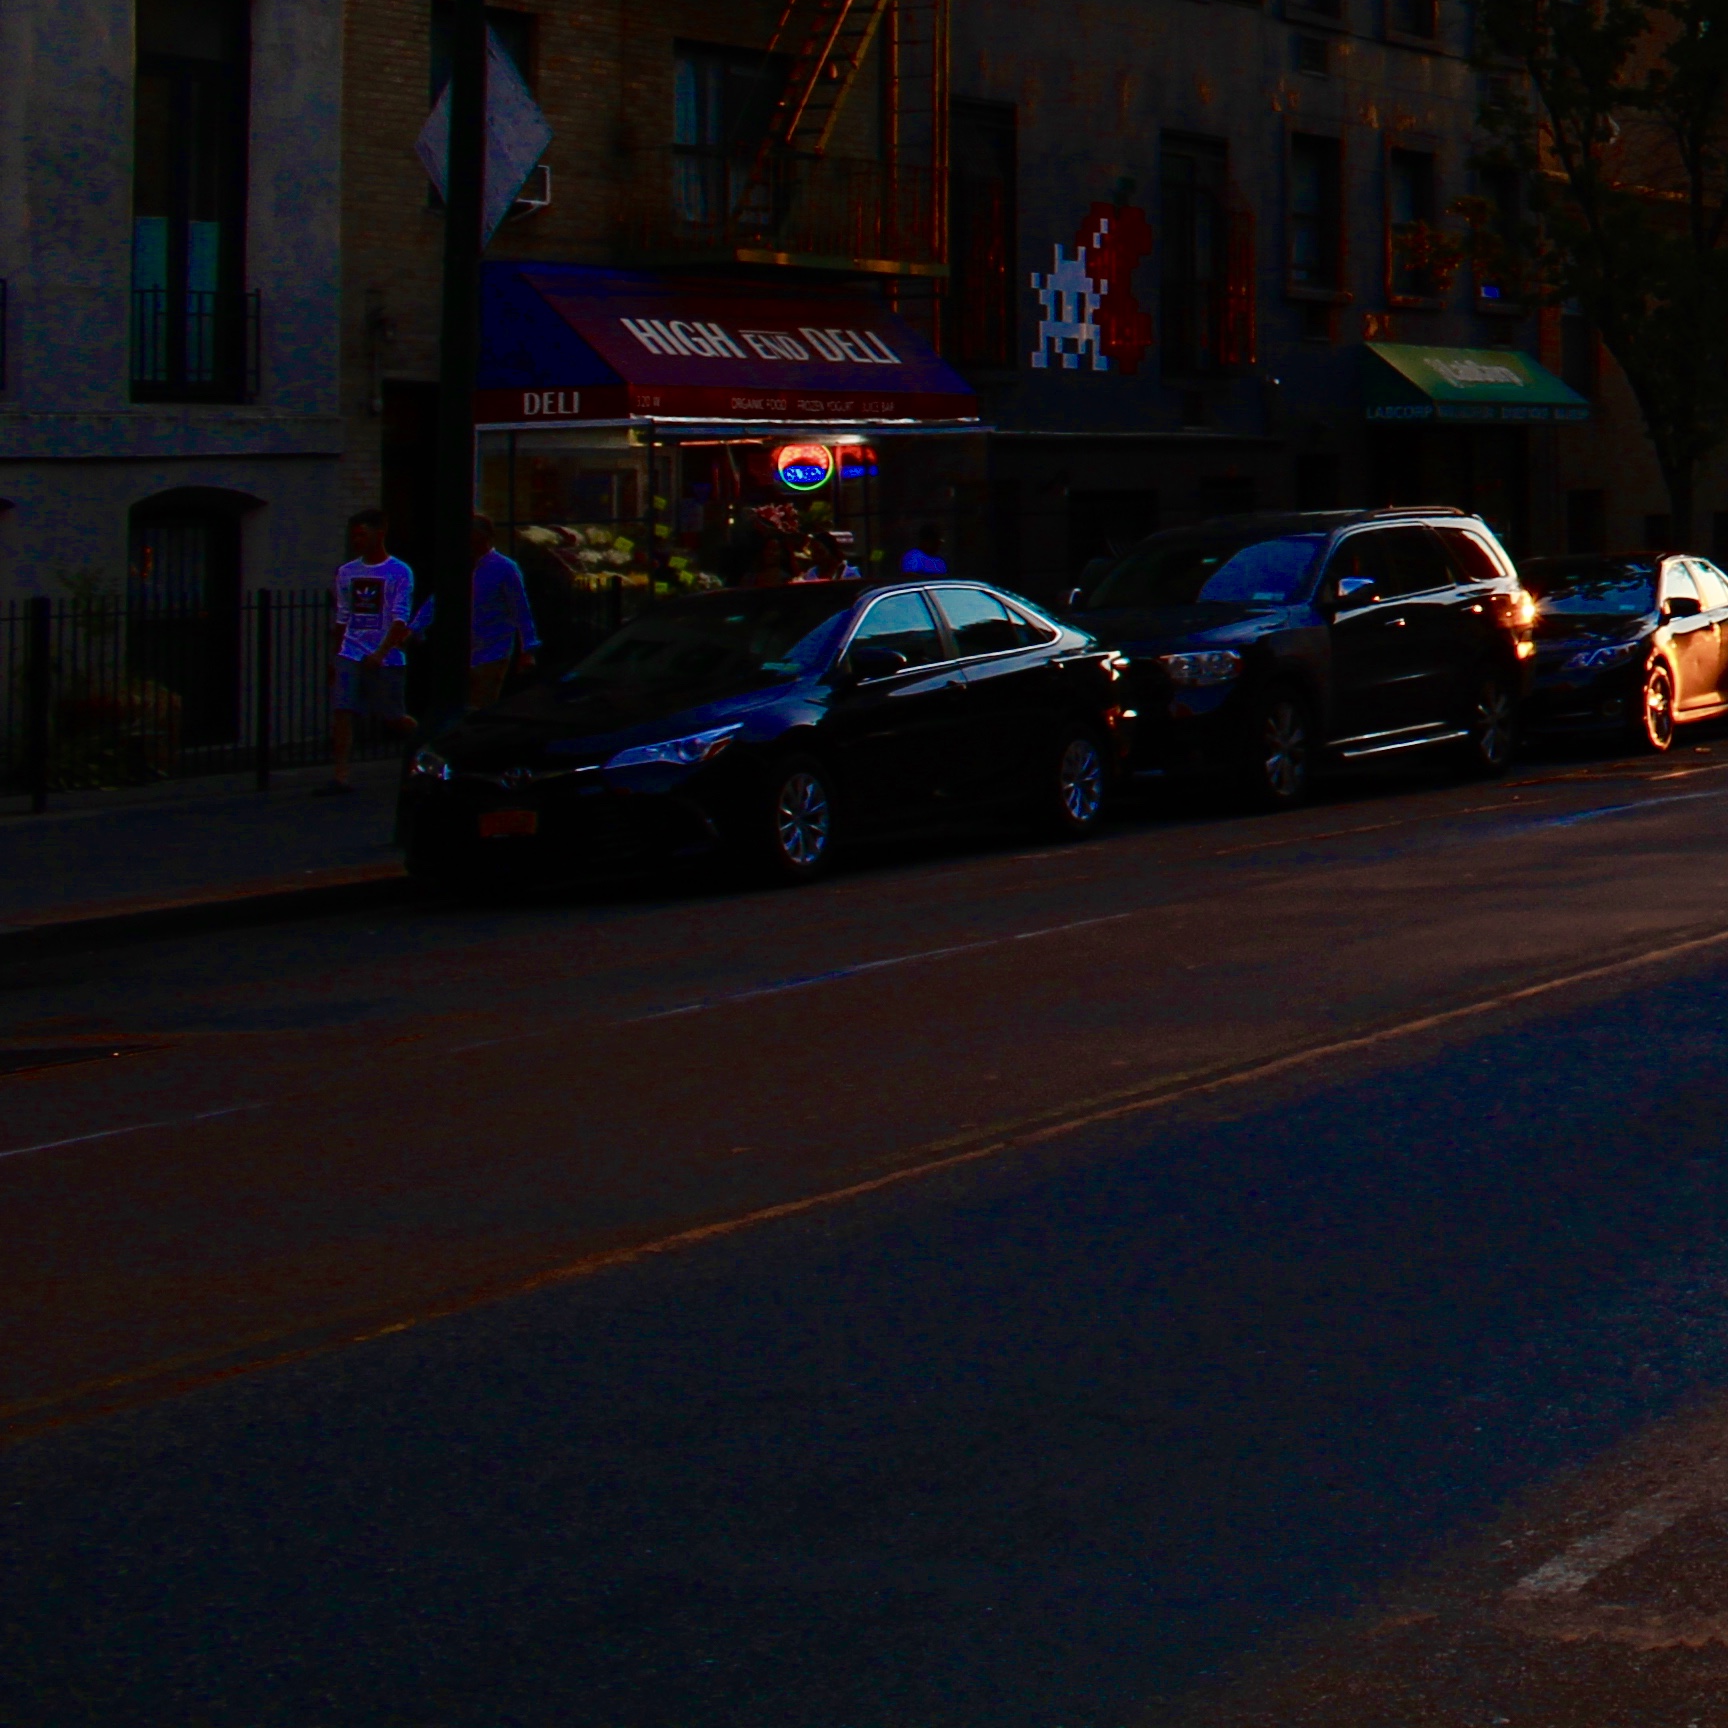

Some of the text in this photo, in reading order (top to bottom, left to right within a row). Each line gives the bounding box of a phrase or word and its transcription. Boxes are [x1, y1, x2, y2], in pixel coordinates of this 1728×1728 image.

[620, 318, 903, 364] HIGH END DELI
[523, 391, 580, 416] DELI
